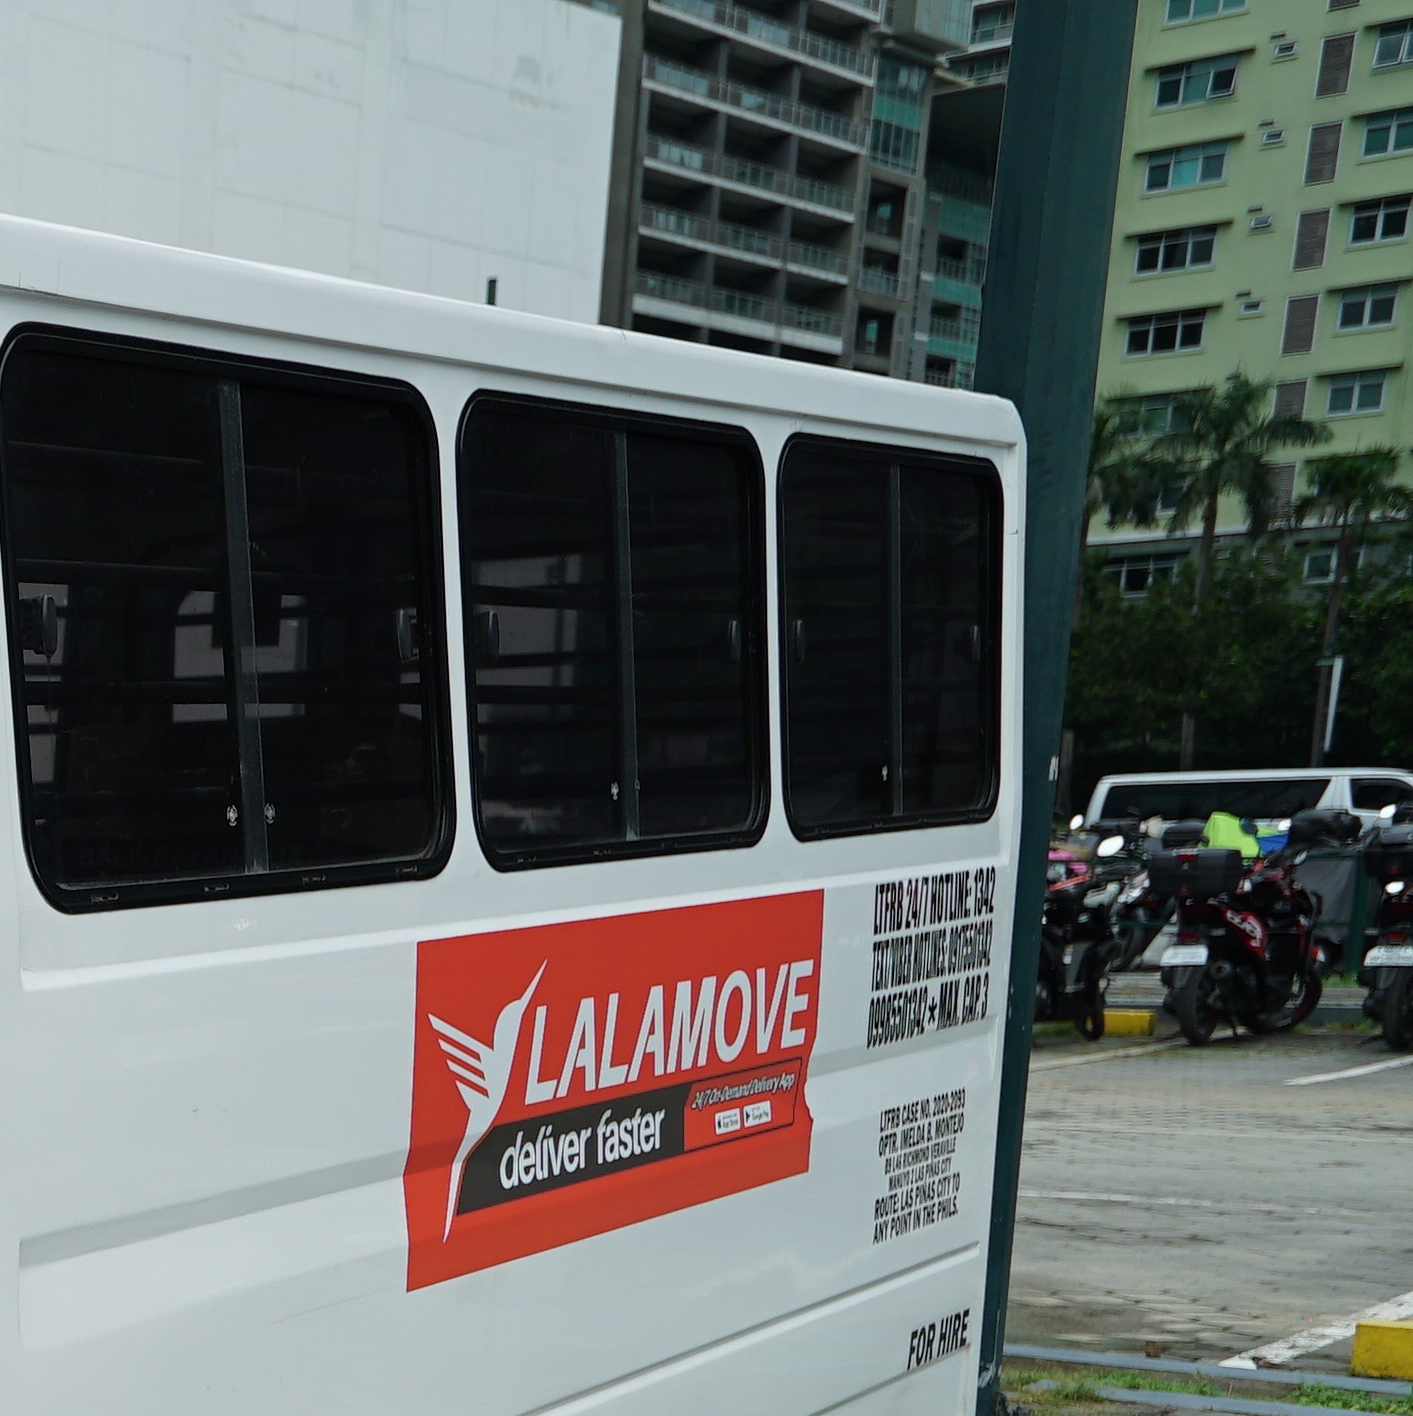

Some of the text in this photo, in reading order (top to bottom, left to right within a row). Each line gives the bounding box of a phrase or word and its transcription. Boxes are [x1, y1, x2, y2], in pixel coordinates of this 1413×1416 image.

[874, 866, 995, 935] LTFRB 24/7 HOTLINE: 1342
[525, 959, 814, 1105] LALAMOVE
[500, 1107, 665, 1189] deliver faster
[880, 1107, 900, 1132] LTFRB
[873, 1219, 889, 1245] ANY
[890, 1211, 912, 1238] POINT
[922, 1203, 935, 1228] THE
[907, 1307, 969, 1371] FOR HIRE
